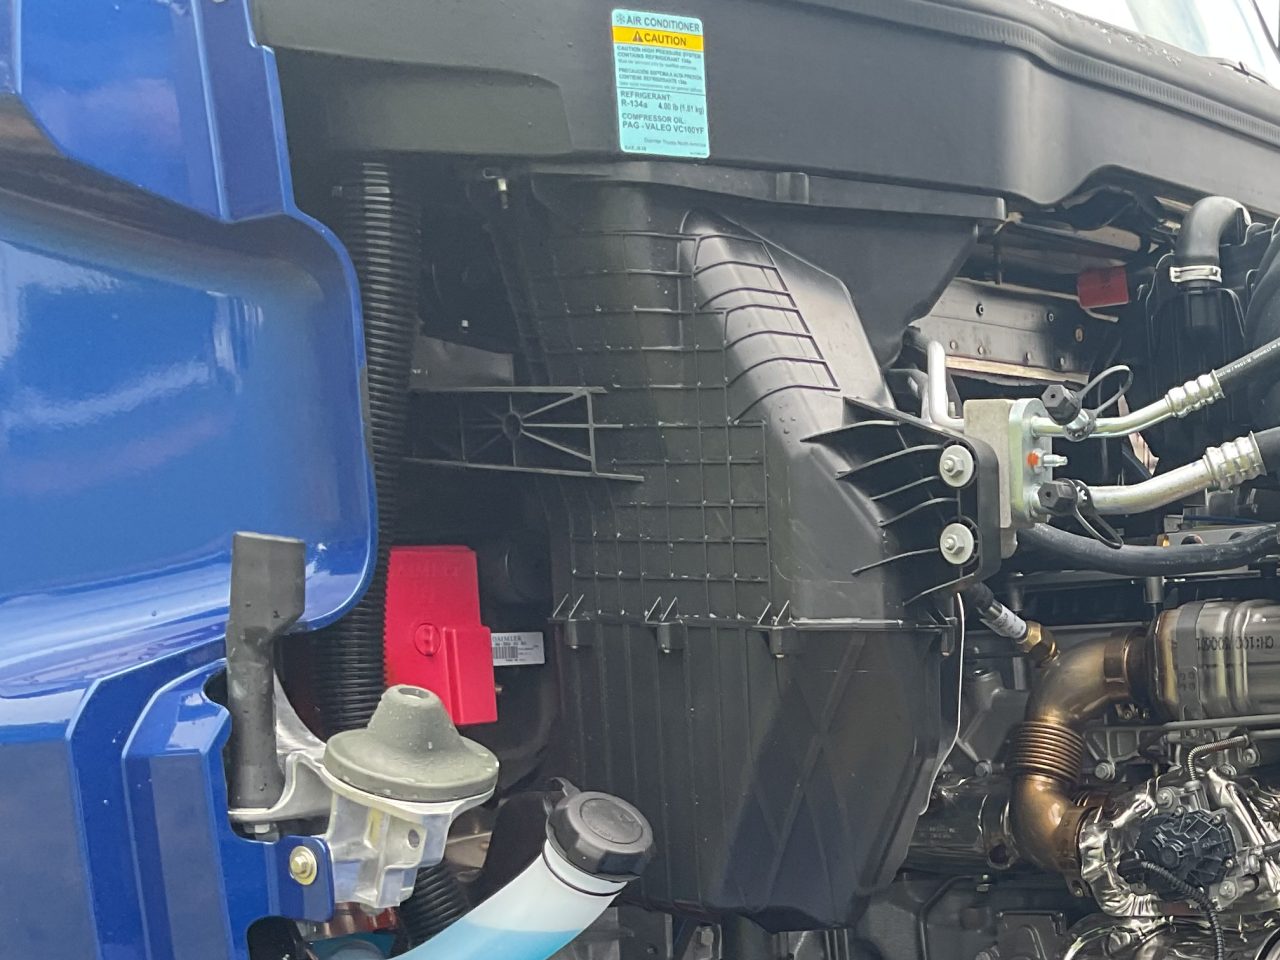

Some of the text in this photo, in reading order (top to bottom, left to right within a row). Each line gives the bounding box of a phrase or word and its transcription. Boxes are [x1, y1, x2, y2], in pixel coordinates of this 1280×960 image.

[626, 16, 700, 32] AIR CONDITIONER
[644, 33, 687, 46] CAUTION
[621, 100, 648, 108] R-134a
[622, 113, 672, 122] COMPRESSOR
[622, 121, 640, 129] PAG
[645, 122, 672, 132] VALEO
